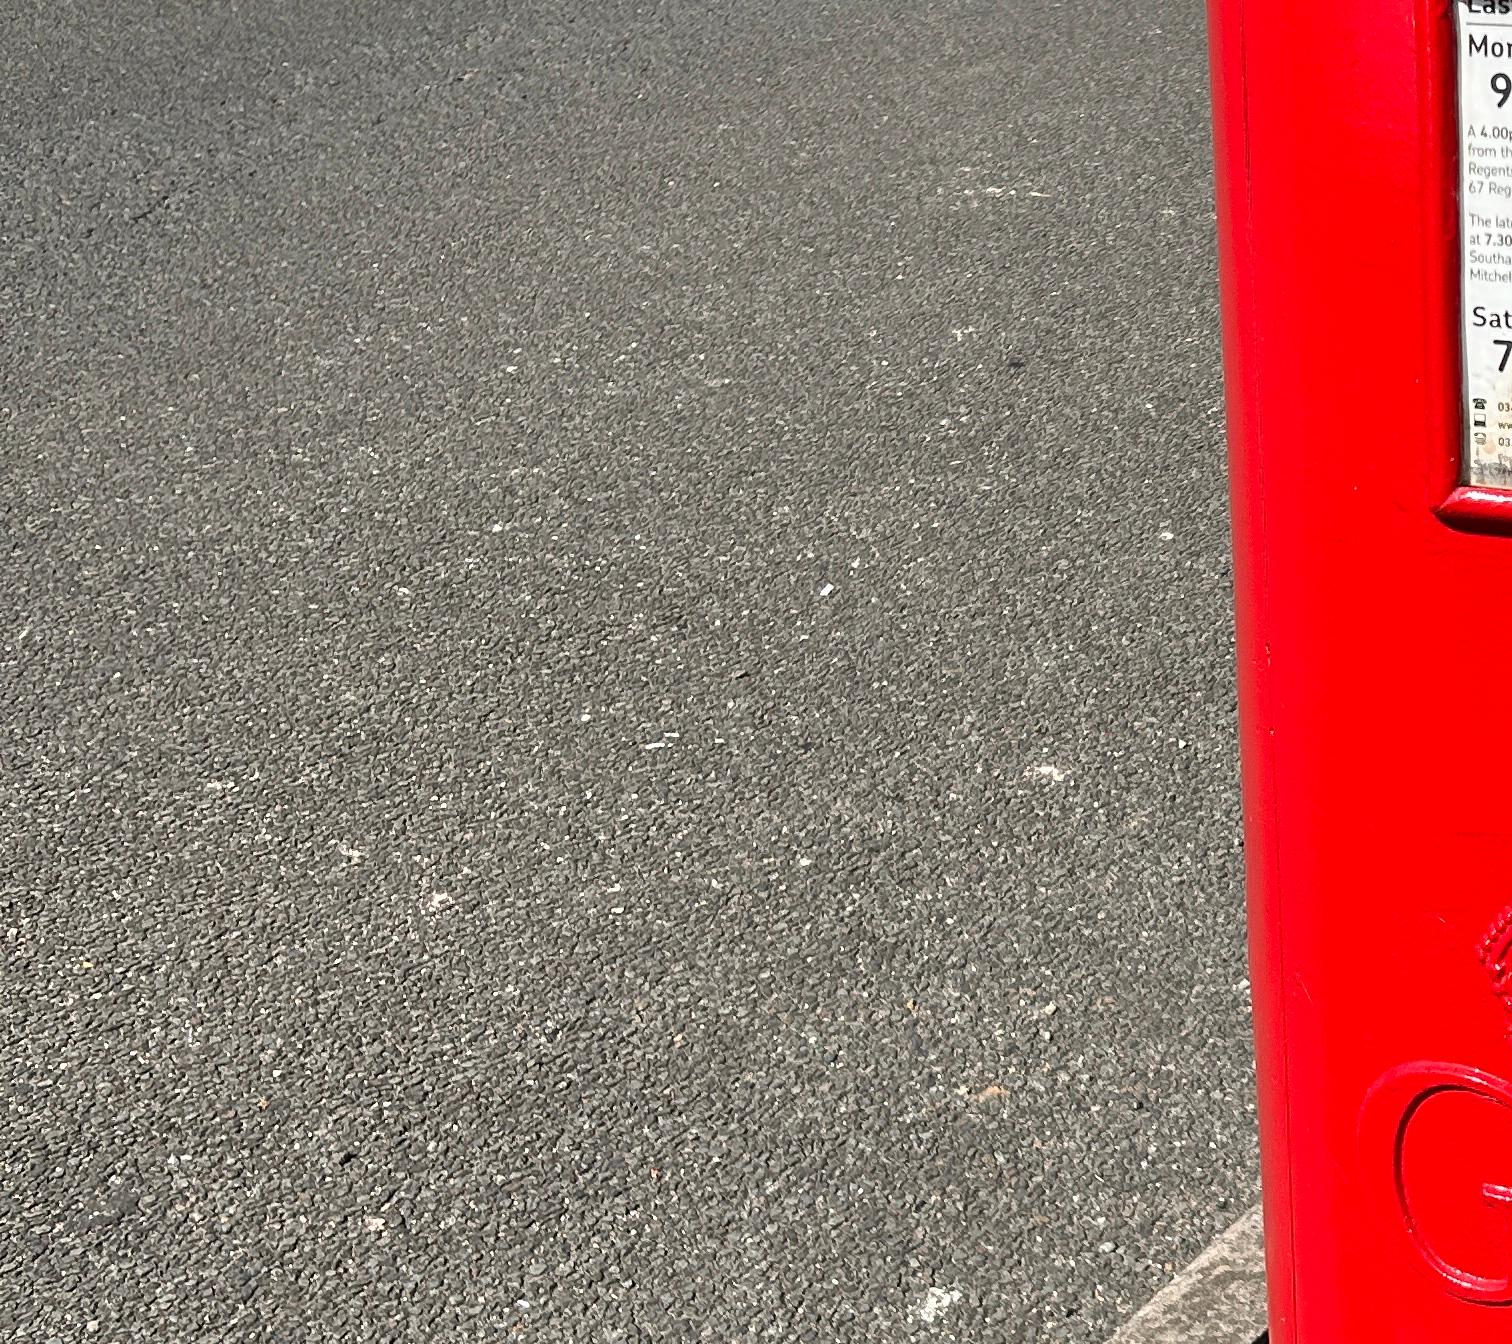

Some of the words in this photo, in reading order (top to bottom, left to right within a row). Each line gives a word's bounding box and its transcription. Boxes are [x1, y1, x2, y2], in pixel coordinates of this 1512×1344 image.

[1467, 124, 1476, 138] A
[1468, 143, 1497, 158] from
[1468, 180, 1484, 194] 67
[1469, 213, 1492, 229] The
[1469, 235, 1481, 246] at
